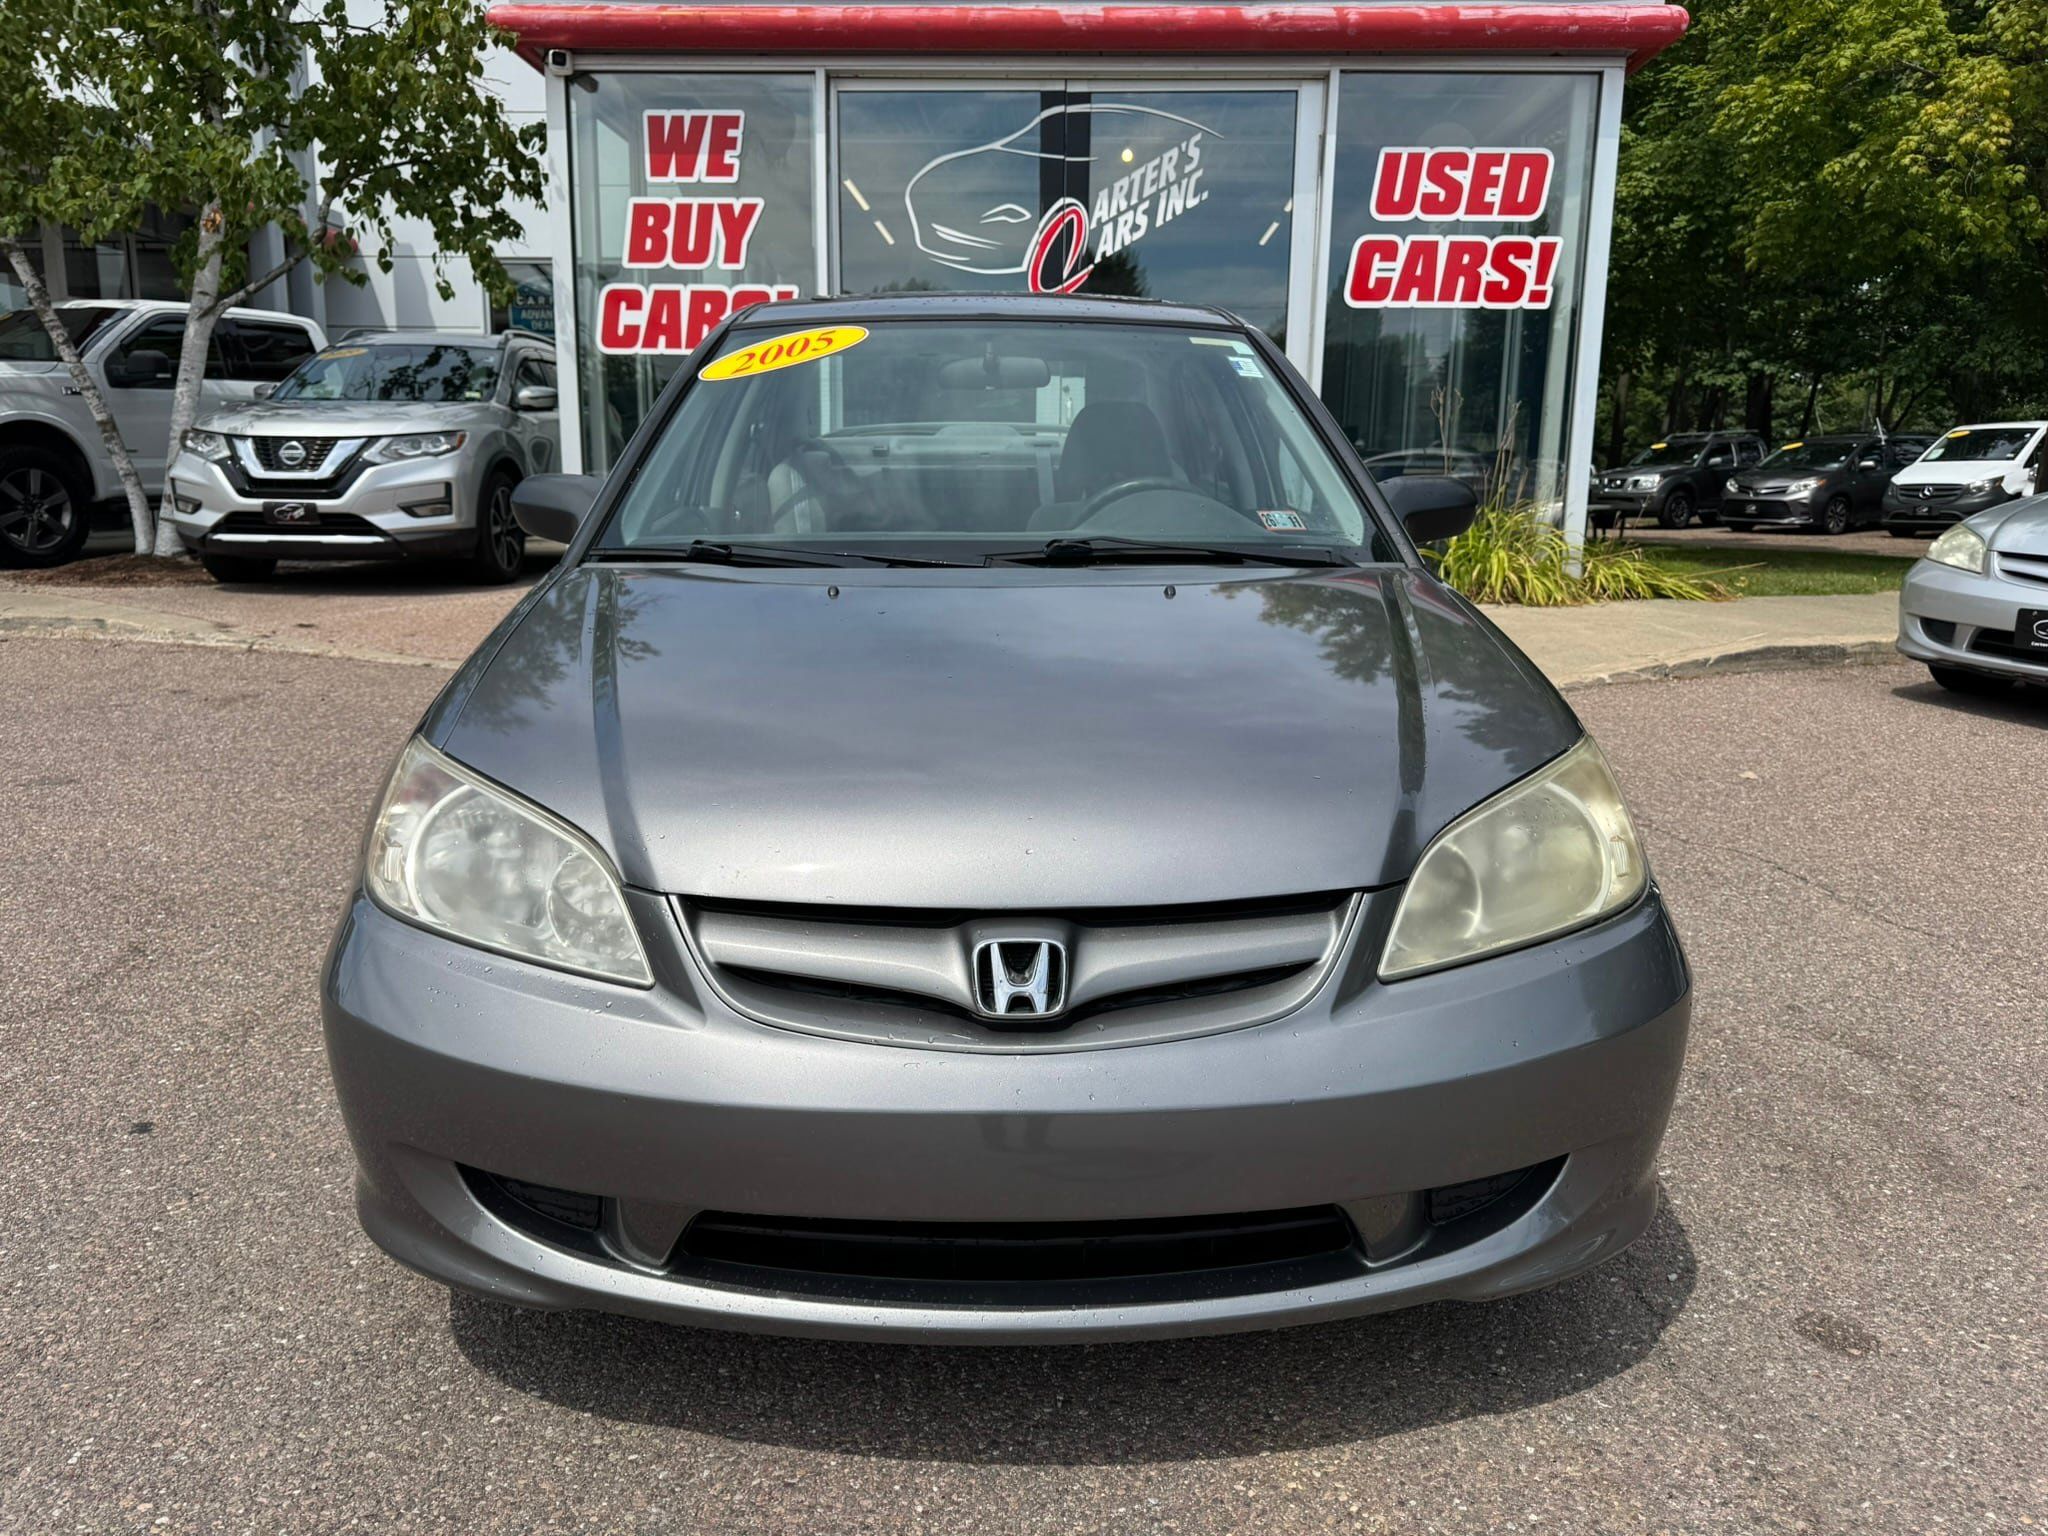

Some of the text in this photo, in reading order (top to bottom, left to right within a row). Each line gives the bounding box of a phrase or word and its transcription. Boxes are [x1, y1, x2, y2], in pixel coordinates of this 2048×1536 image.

[645, 112, 743, 180] WE
[1155, 168, 1209, 228] INC.
[1372, 149, 1552, 219] USED
[625, 200, 762, 268] BUY
[1346, 237, 1561, 307] CARS!
[598, 286, 798, 352] CAR
[720, 329, 837, 376] 2005
